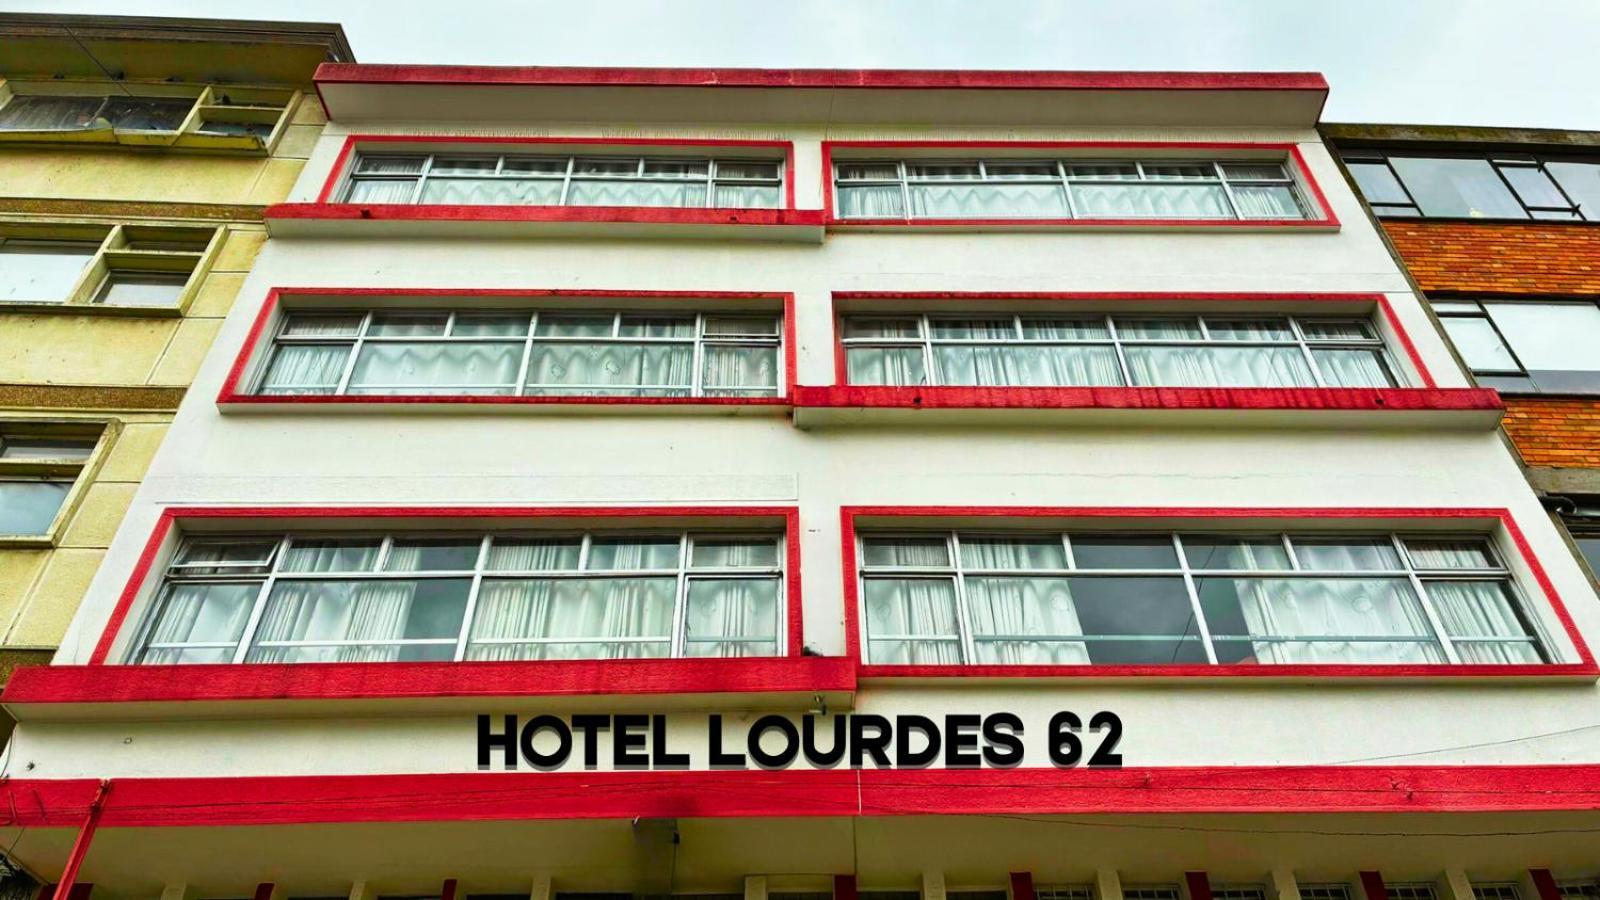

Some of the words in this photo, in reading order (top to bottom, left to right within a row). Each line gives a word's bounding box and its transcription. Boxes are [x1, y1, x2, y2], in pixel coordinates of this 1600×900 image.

[477, 714, 690, 769] HOTEL
[708, 713, 1024, 769] LOURDES
[1048, 711, 1123, 767] 62
